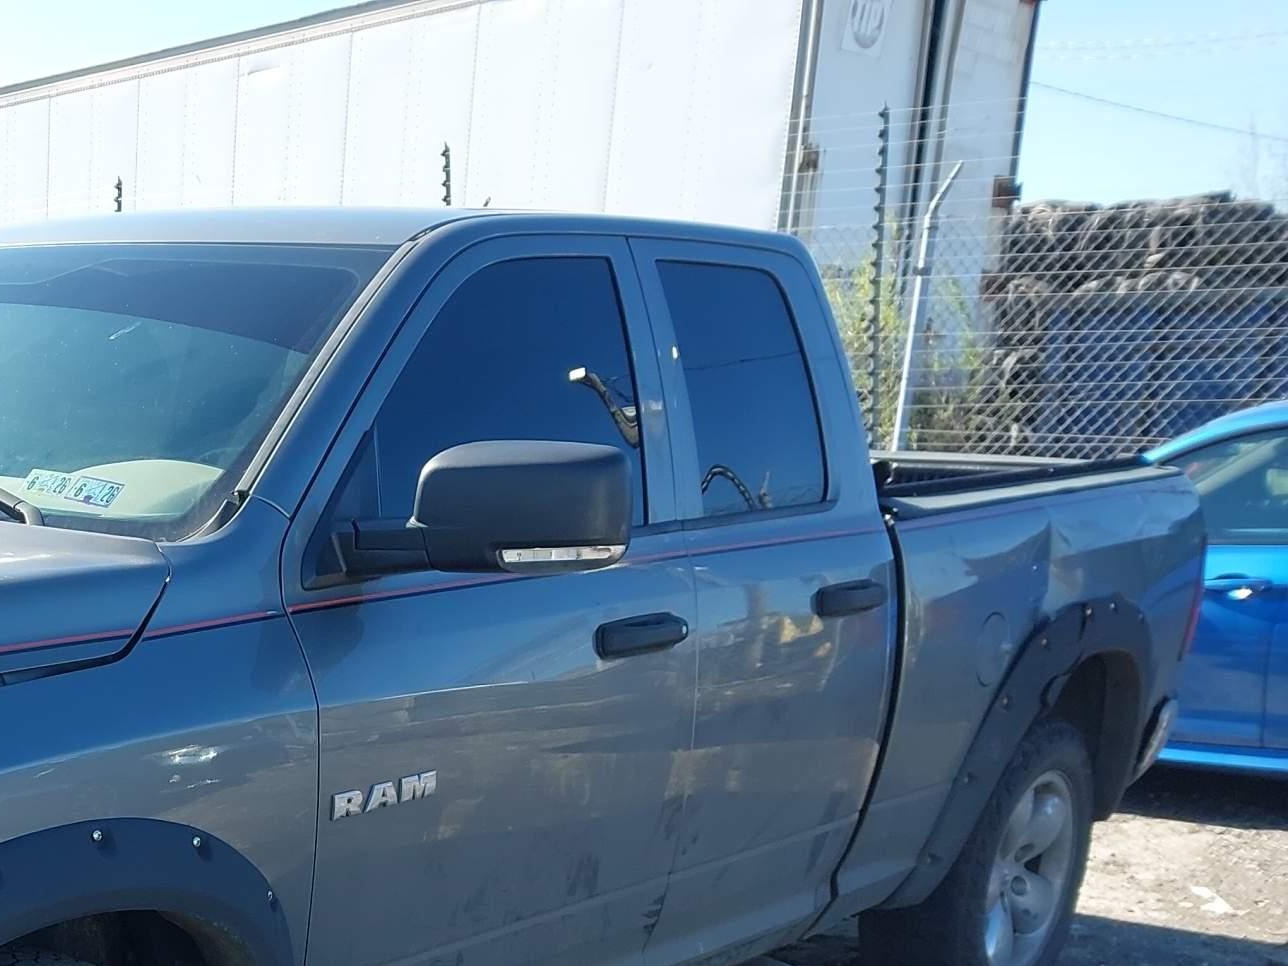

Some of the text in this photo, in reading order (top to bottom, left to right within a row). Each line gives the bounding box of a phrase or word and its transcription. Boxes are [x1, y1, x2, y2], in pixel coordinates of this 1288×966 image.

[53, 476, 71, 494] 26
[100, 486, 120, 503] 26
[330, 769, 437, 821] RAM
